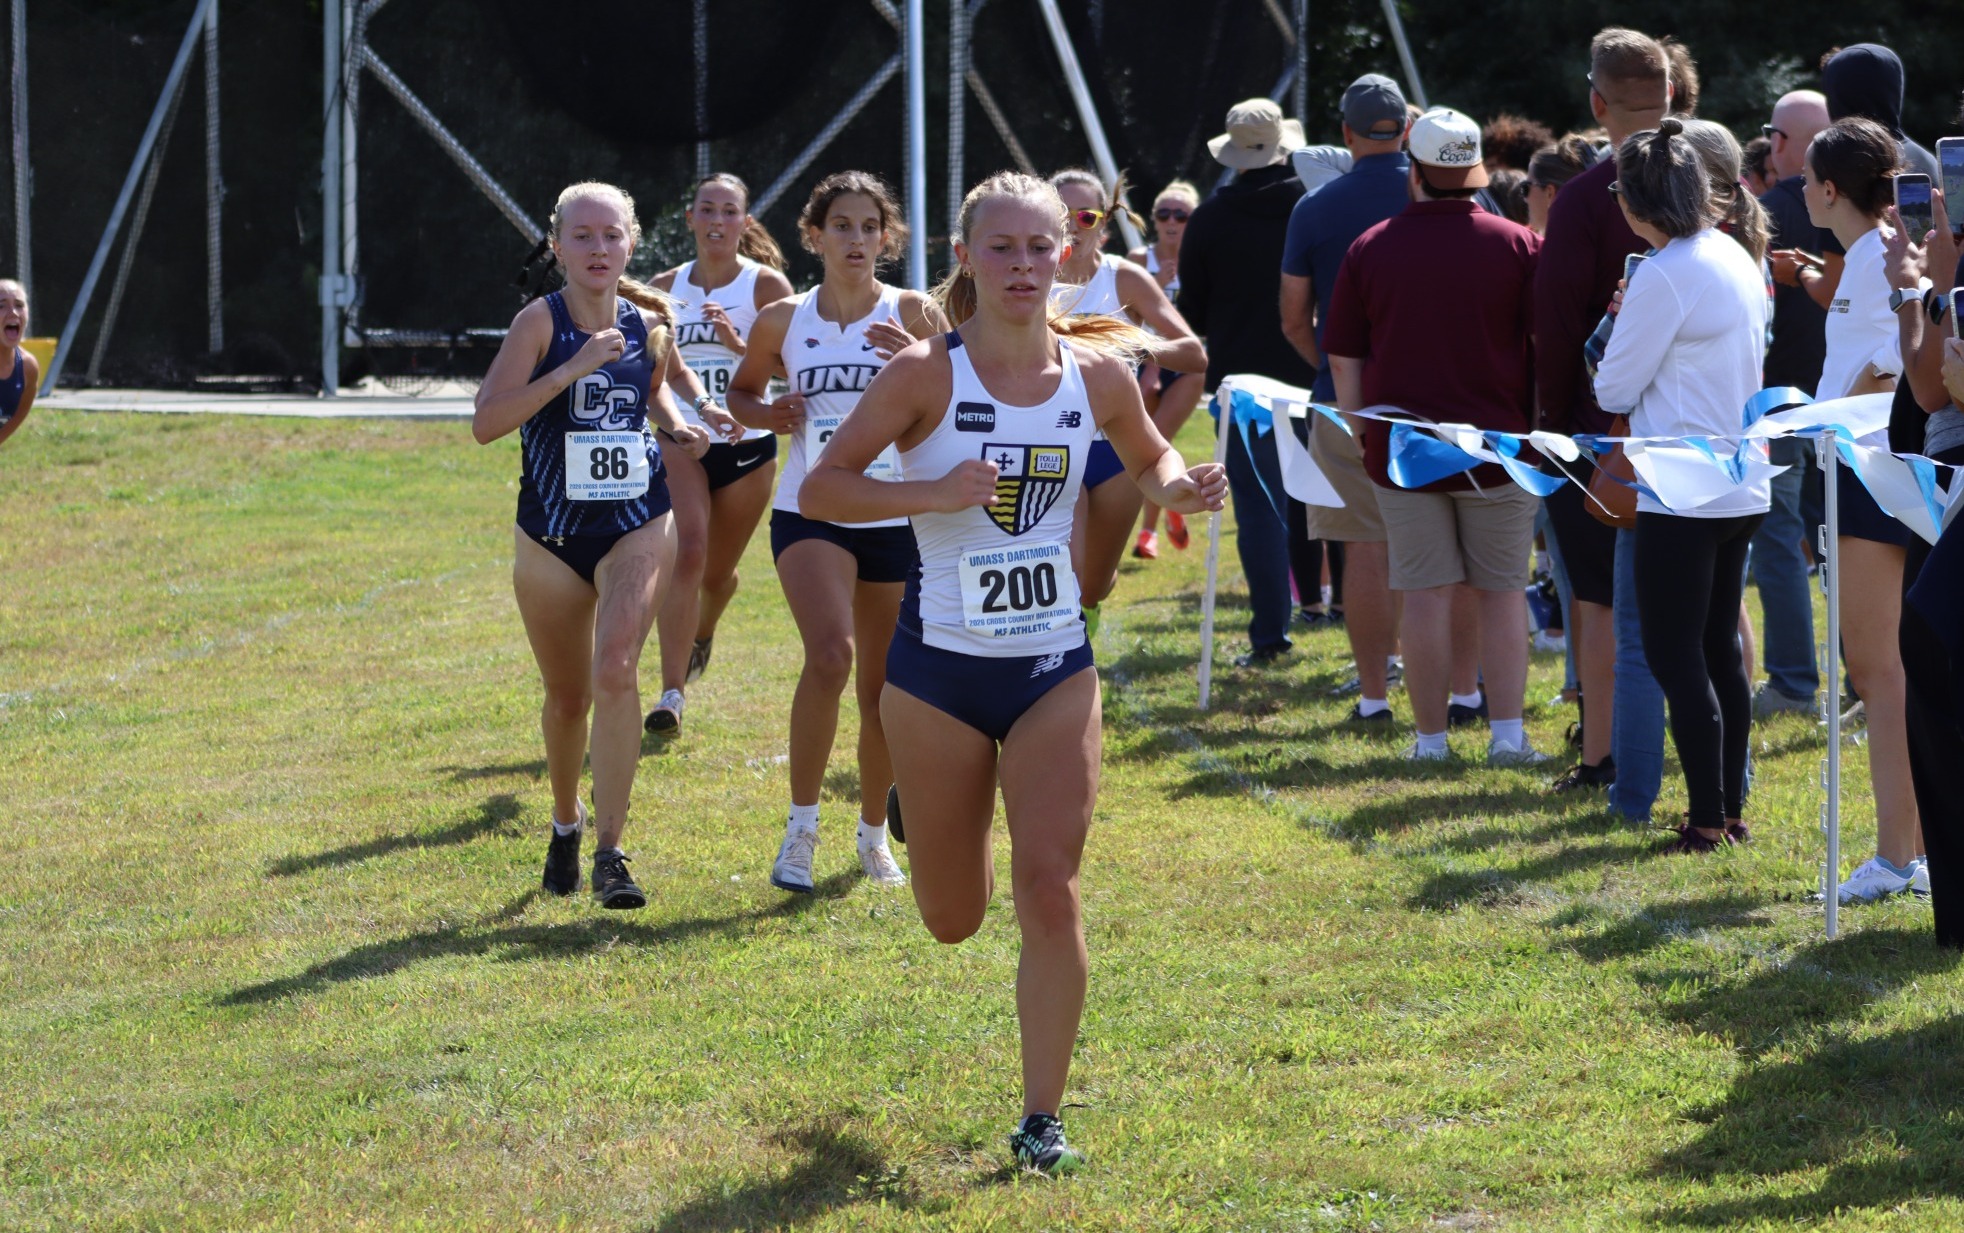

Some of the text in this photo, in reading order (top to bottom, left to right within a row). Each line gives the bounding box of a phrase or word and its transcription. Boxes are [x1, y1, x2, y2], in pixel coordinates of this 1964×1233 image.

[693, 368, 729, 394] 19
[569, 369, 640, 431] CC
[814, 418, 838, 427] UMASS
[957, 411, 994, 423] METRO
[573, 435, 639, 444] UMASS DARTMOUTH
[590, 446, 629, 481] 86
[600, 490, 630, 498] ATHLETIC
[969, 545, 1060, 567] UMASS DARTMOUTH
[979, 562, 1058, 613] 200
[987, 616, 1006, 625] CROSS
[1009, 613, 1034, 624] COUNTRY
[1036, 607, 1073, 620] INVITATIONAL
[994, 622, 1051, 637] MF ATHLETIC
